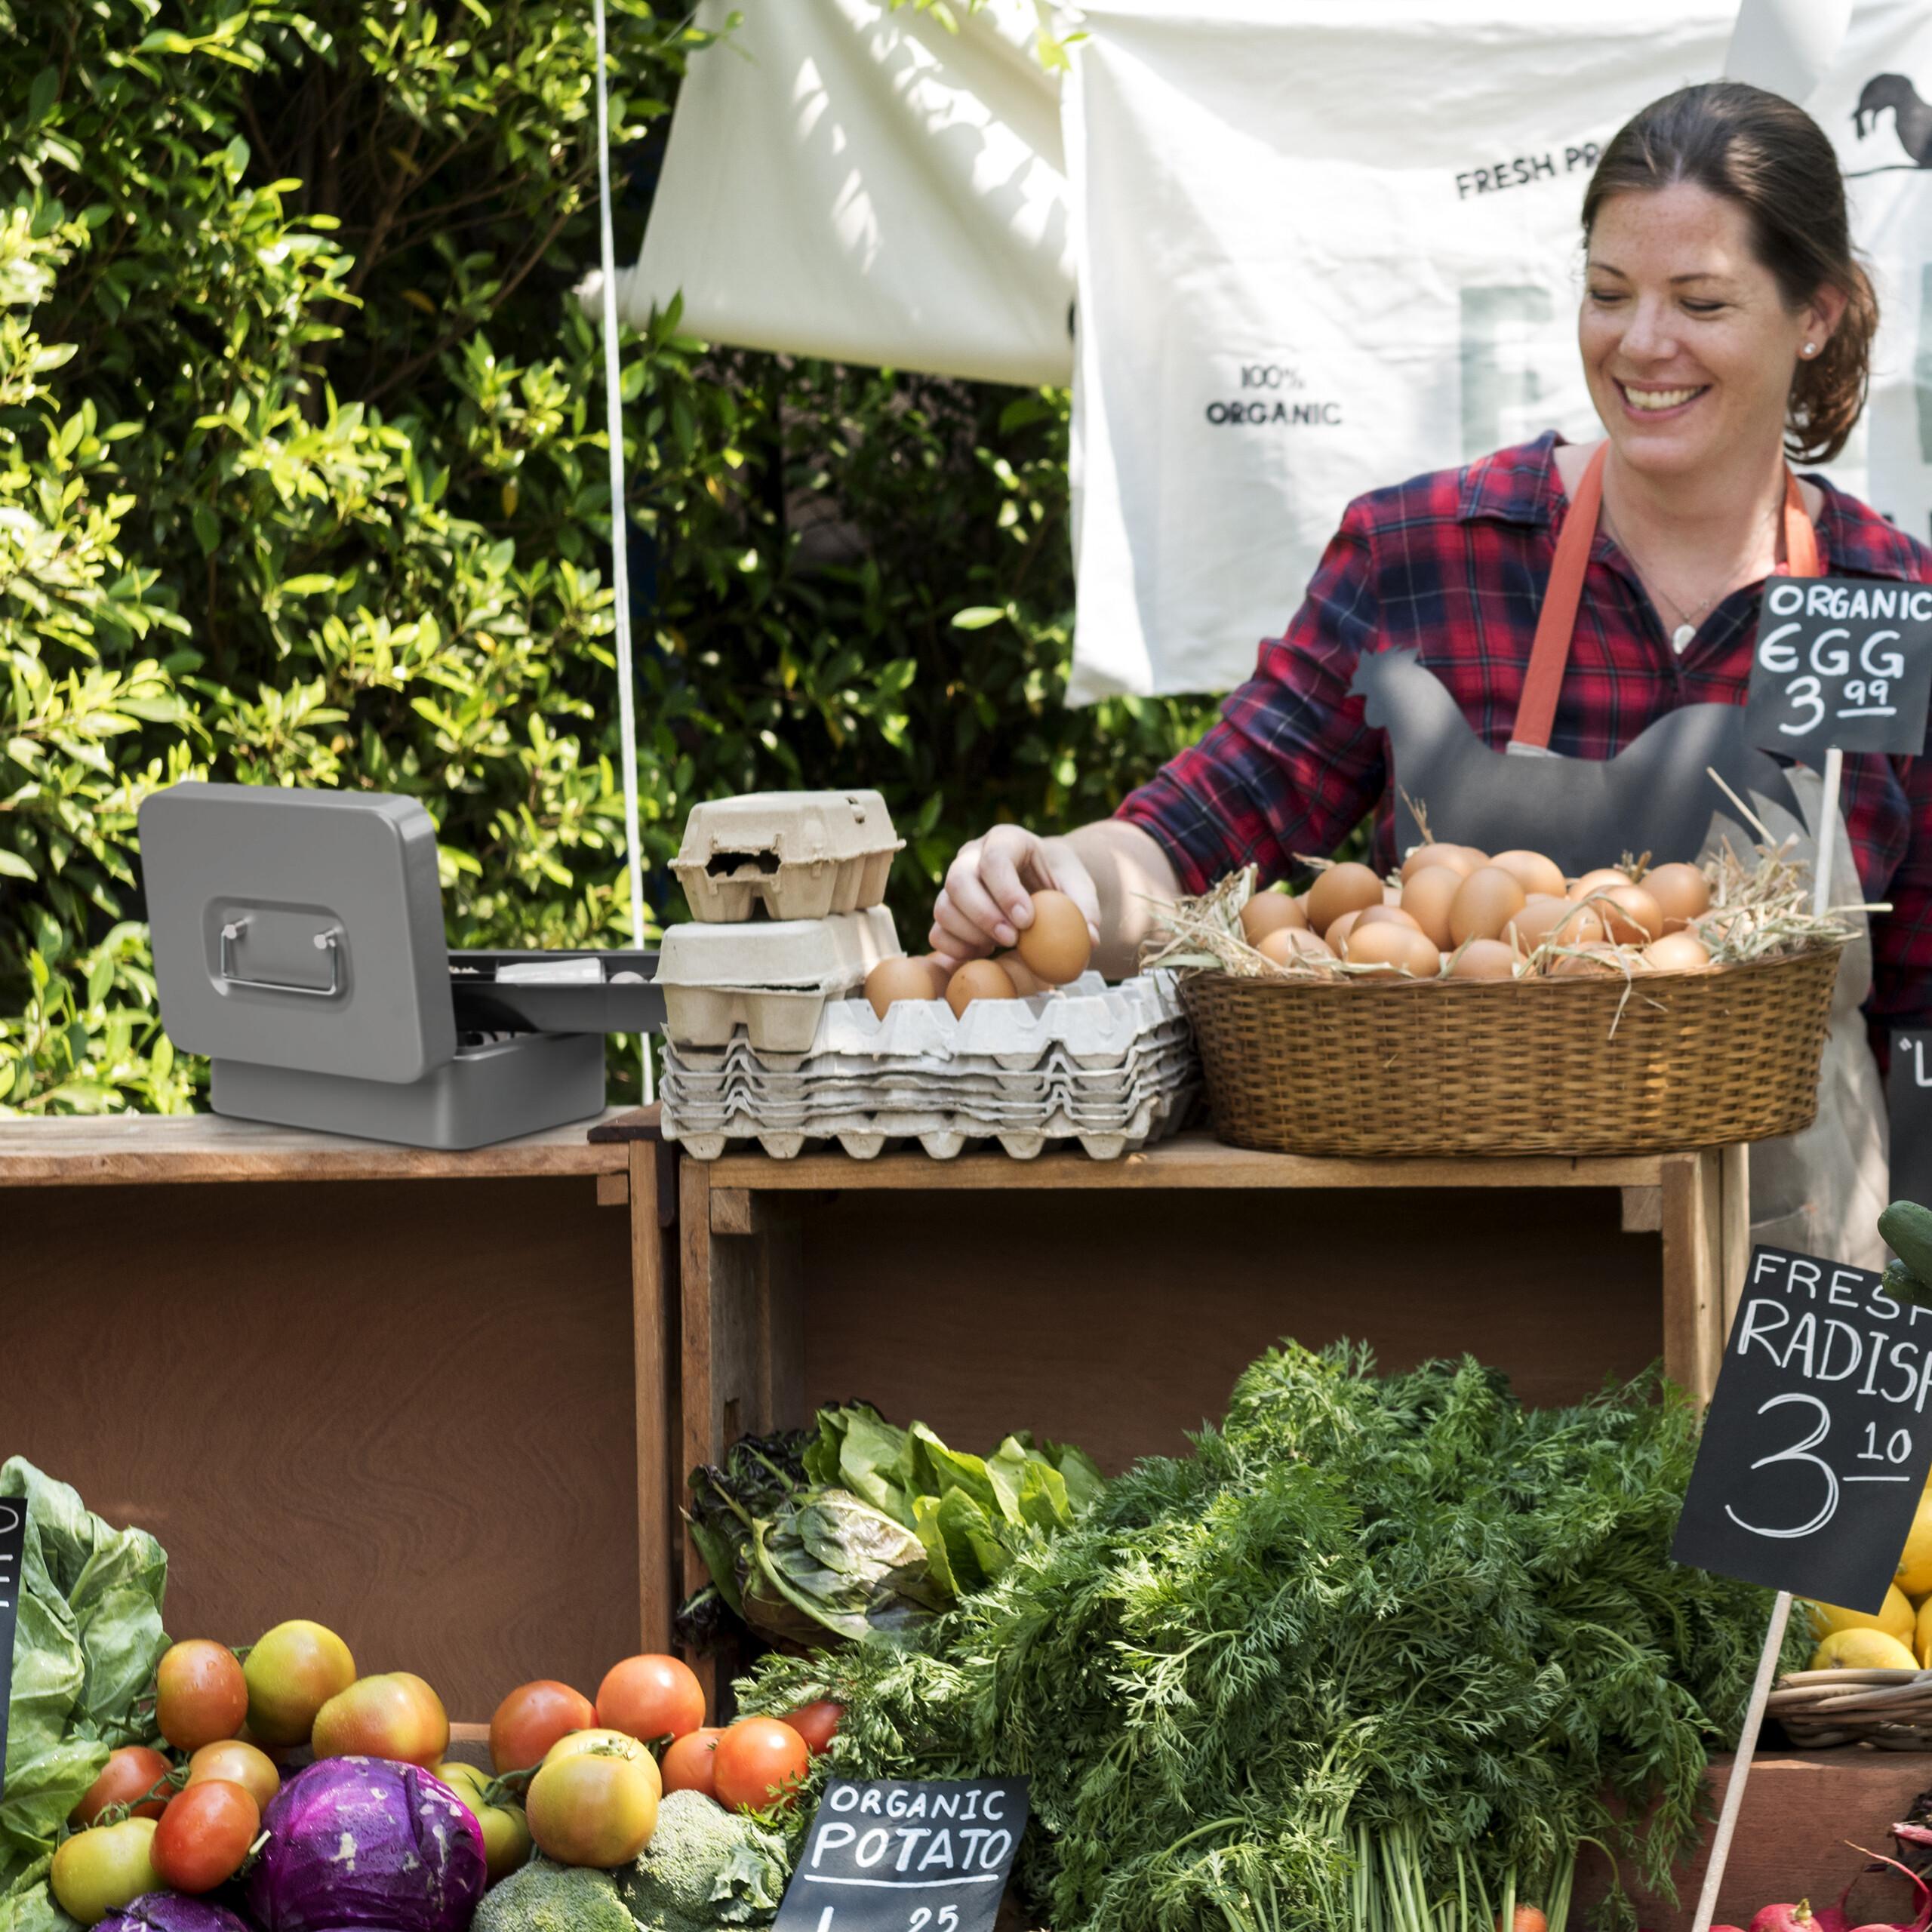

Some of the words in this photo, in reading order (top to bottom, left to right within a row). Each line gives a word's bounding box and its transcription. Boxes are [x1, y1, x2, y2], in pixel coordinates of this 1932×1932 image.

[1456, 153, 1555, 200] FRESH
[1241, 365, 1306, 390] 100%
[1206, 401, 1342, 426] ORGANIC
[1769, 584, 1932, 622] ORGANIC
[1758, 623, 1905, 679] EGG
[1779, 675, 1826, 736] 3
[1843, 679, 1889, 706] 99
[1725, 1392, 1840, 1539] 3
[1857, 1422, 1912, 1464] 10
[830, 1785, 1005, 1821] ORGANIC
[811, 1822, 1013, 1872] POTATO
